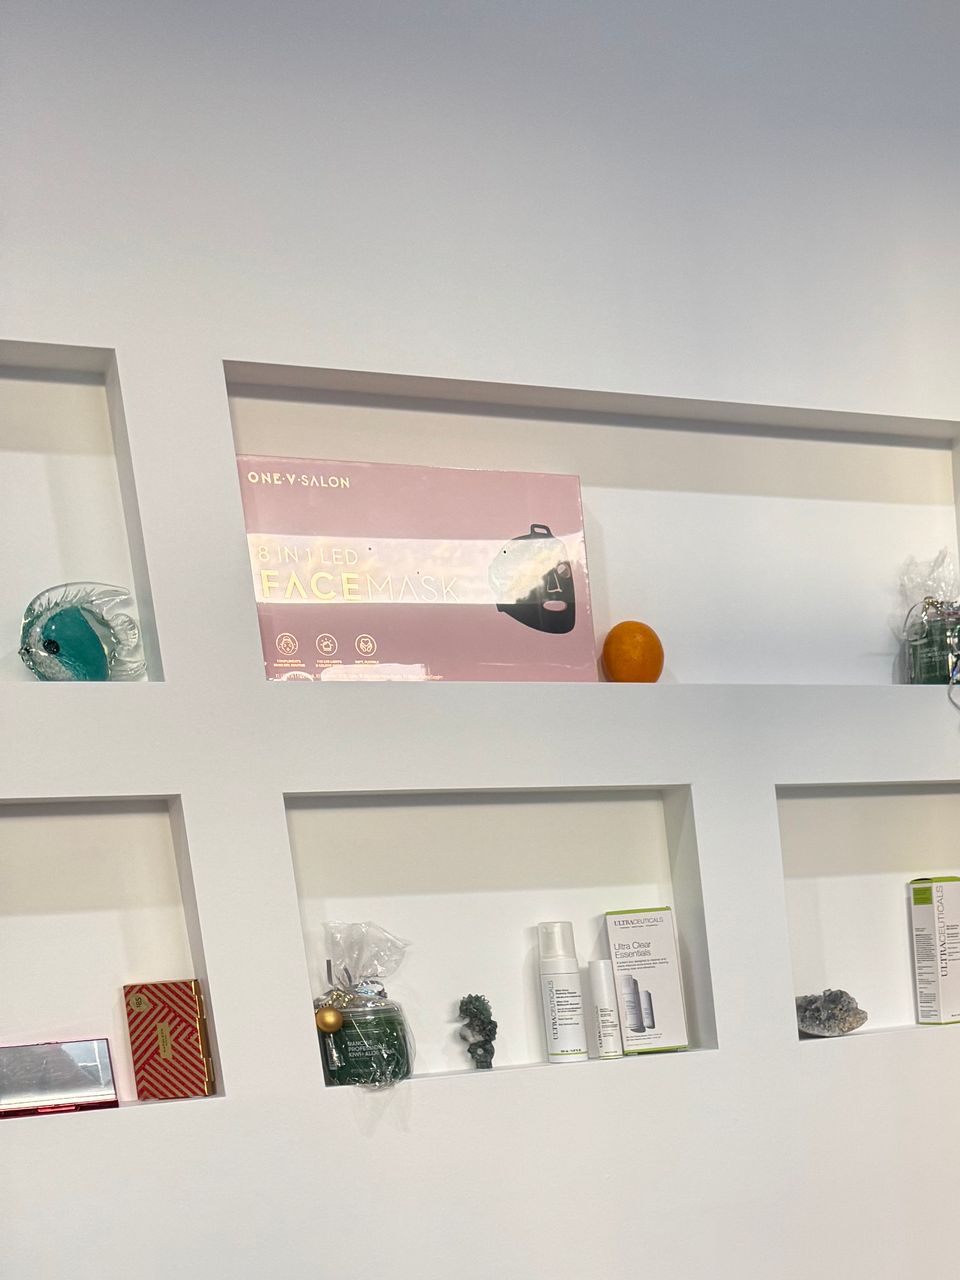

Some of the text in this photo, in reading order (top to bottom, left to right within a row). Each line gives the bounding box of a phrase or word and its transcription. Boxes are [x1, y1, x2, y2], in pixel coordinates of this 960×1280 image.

[258, 545, 358, 565] 8 IN 1 LED
[614, 917, 664, 926] ULTRACEUTICALS
[937, 885, 948, 977] ULTRACEUTICALS
[632, 941, 651, 949] Clear
[615, 950, 651, 959] Essentials
[548, 980, 559, 1040] ULTRACEUTICALS
